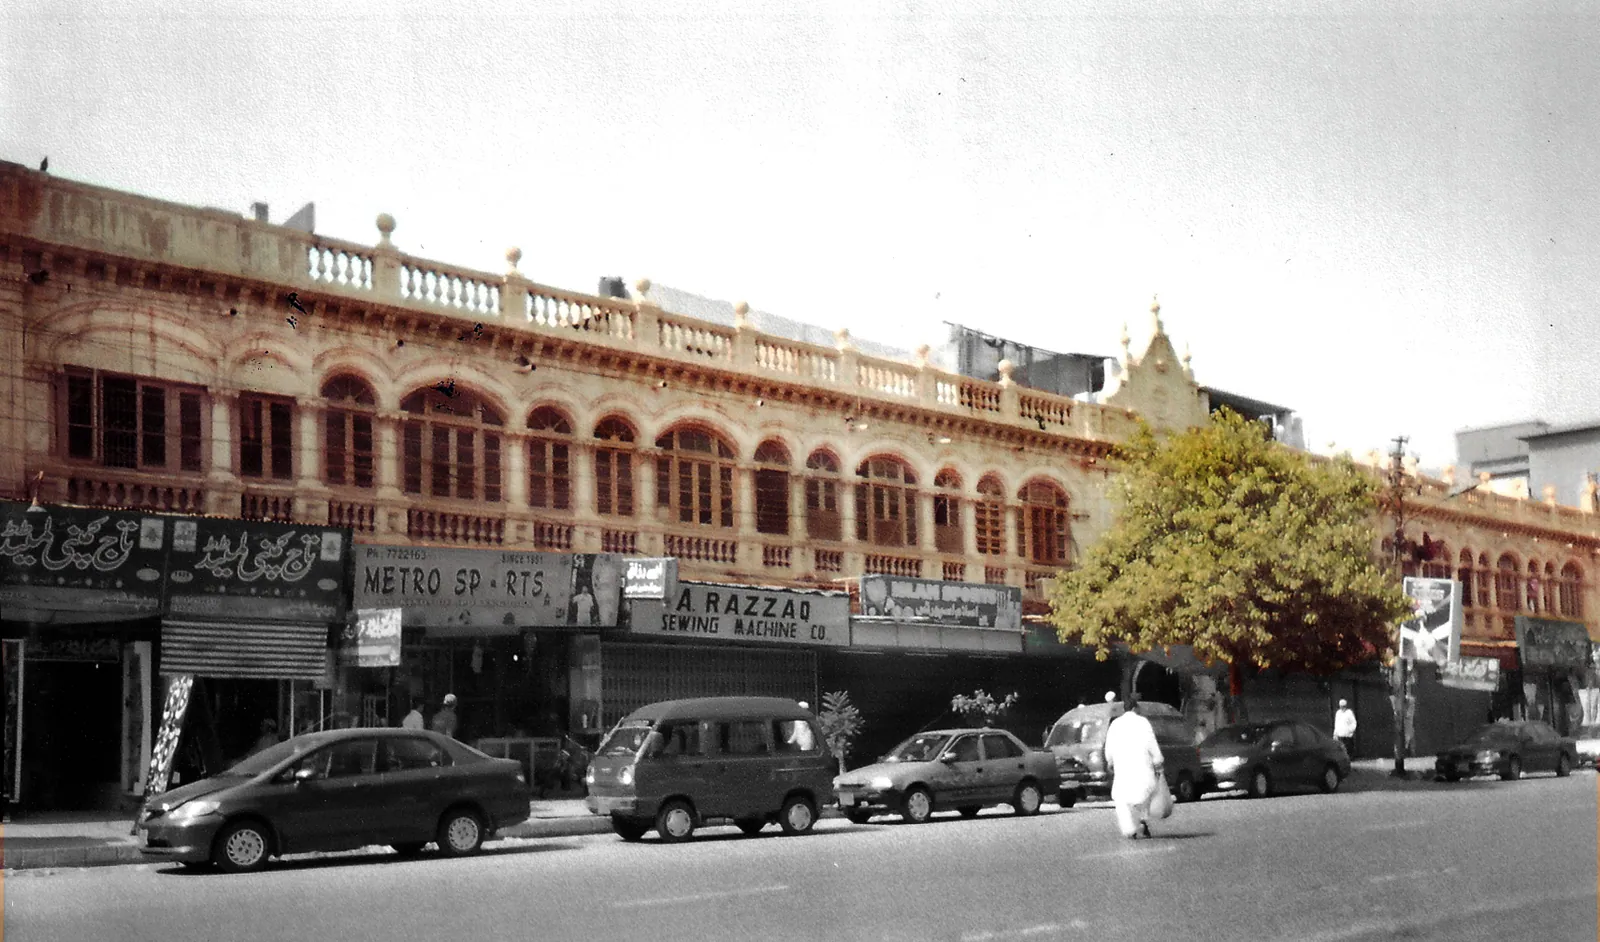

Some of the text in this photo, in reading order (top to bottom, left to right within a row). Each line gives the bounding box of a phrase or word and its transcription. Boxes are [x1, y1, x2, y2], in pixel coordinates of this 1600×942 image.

[92, 518, 139, 572] تاج
[281, 533, 321, 582] تاج
[363, 566, 441, 595] METRO
[705, 591, 811, 623] RAZZAQ
[662, 613, 719, 634] SEWING
[734, 617, 798, 639] MACHINE
